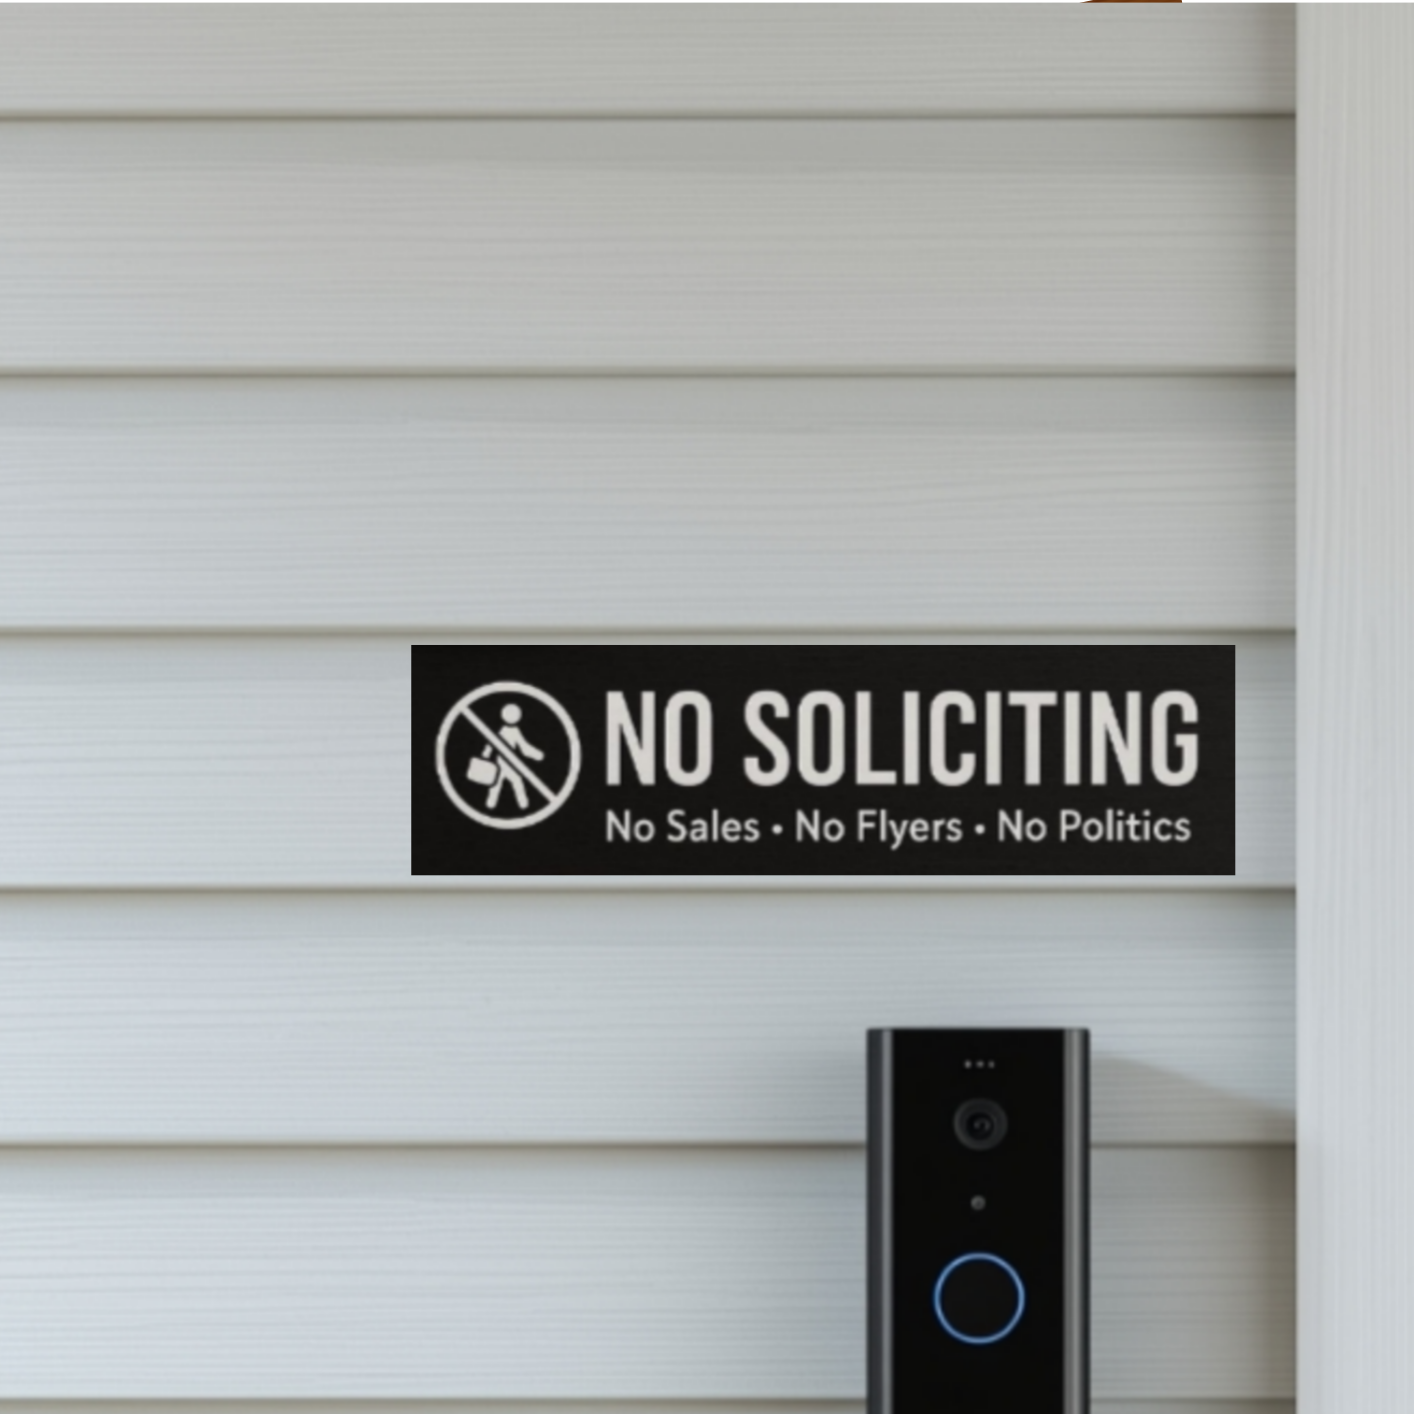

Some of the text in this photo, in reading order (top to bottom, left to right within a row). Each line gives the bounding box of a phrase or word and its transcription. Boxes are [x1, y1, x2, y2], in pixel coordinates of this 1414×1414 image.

[605, 689, 1199, 788] NO SOLICITING
[605, 807, 1192, 851] No Sales No Flyers No Politics
